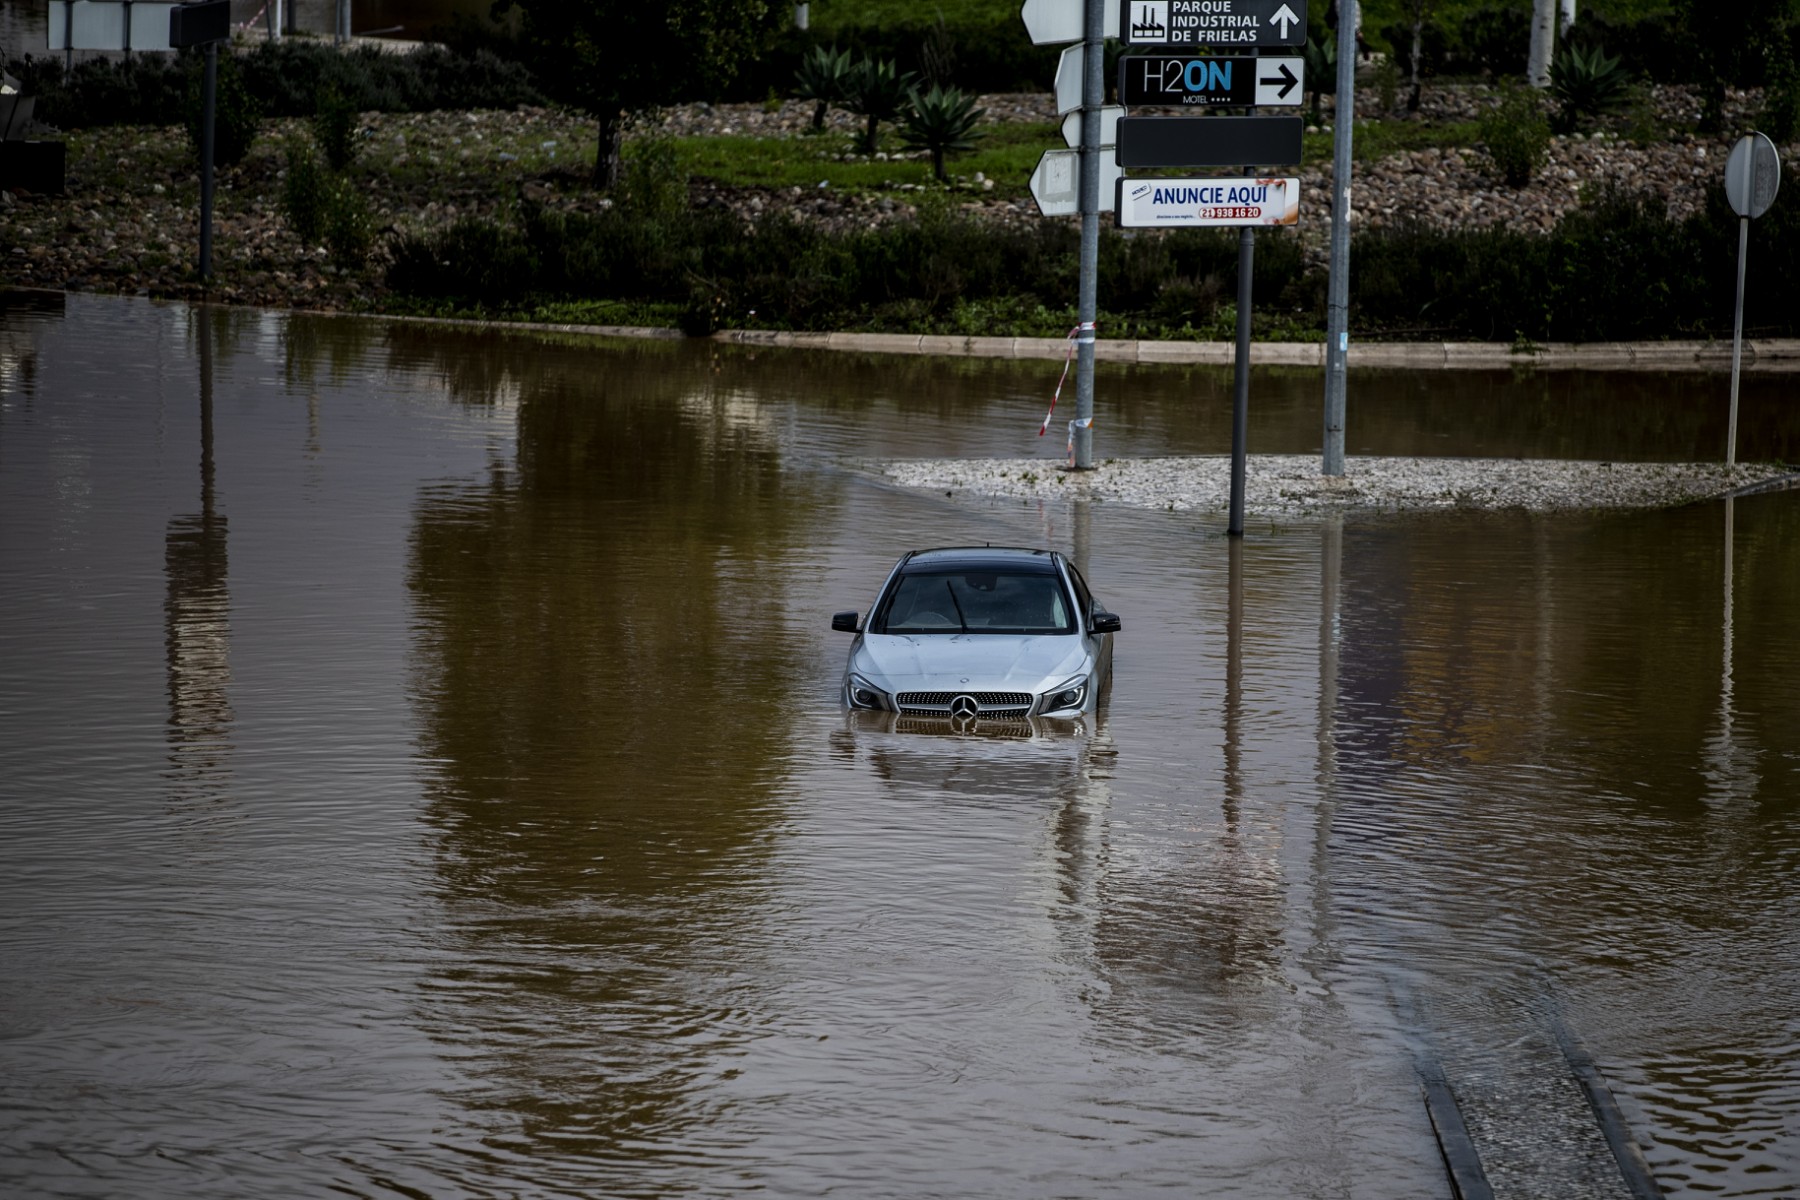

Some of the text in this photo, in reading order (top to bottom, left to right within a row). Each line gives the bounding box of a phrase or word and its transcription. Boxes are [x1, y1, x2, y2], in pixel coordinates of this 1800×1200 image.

[1172, 1, 1231, 14] PARQUE
[1172, 15, 1260, 27] INDUSTRIAL
[1172, 30, 1257, 42] DE FRIELAS
[1144, 60, 1232, 92] H2ON
[1183, 95, 1208, 104] MOTEL
[1152, 187, 1223, 204] ANUNCIE
[1227, 186, 1267, 206] AQUI
[1202, 208, 1212, 218] 21
[1216, 208, 1234, 218] 938
[1235, 208, 1246, 217] 16
[1247, 207, 1259, 217] 20
